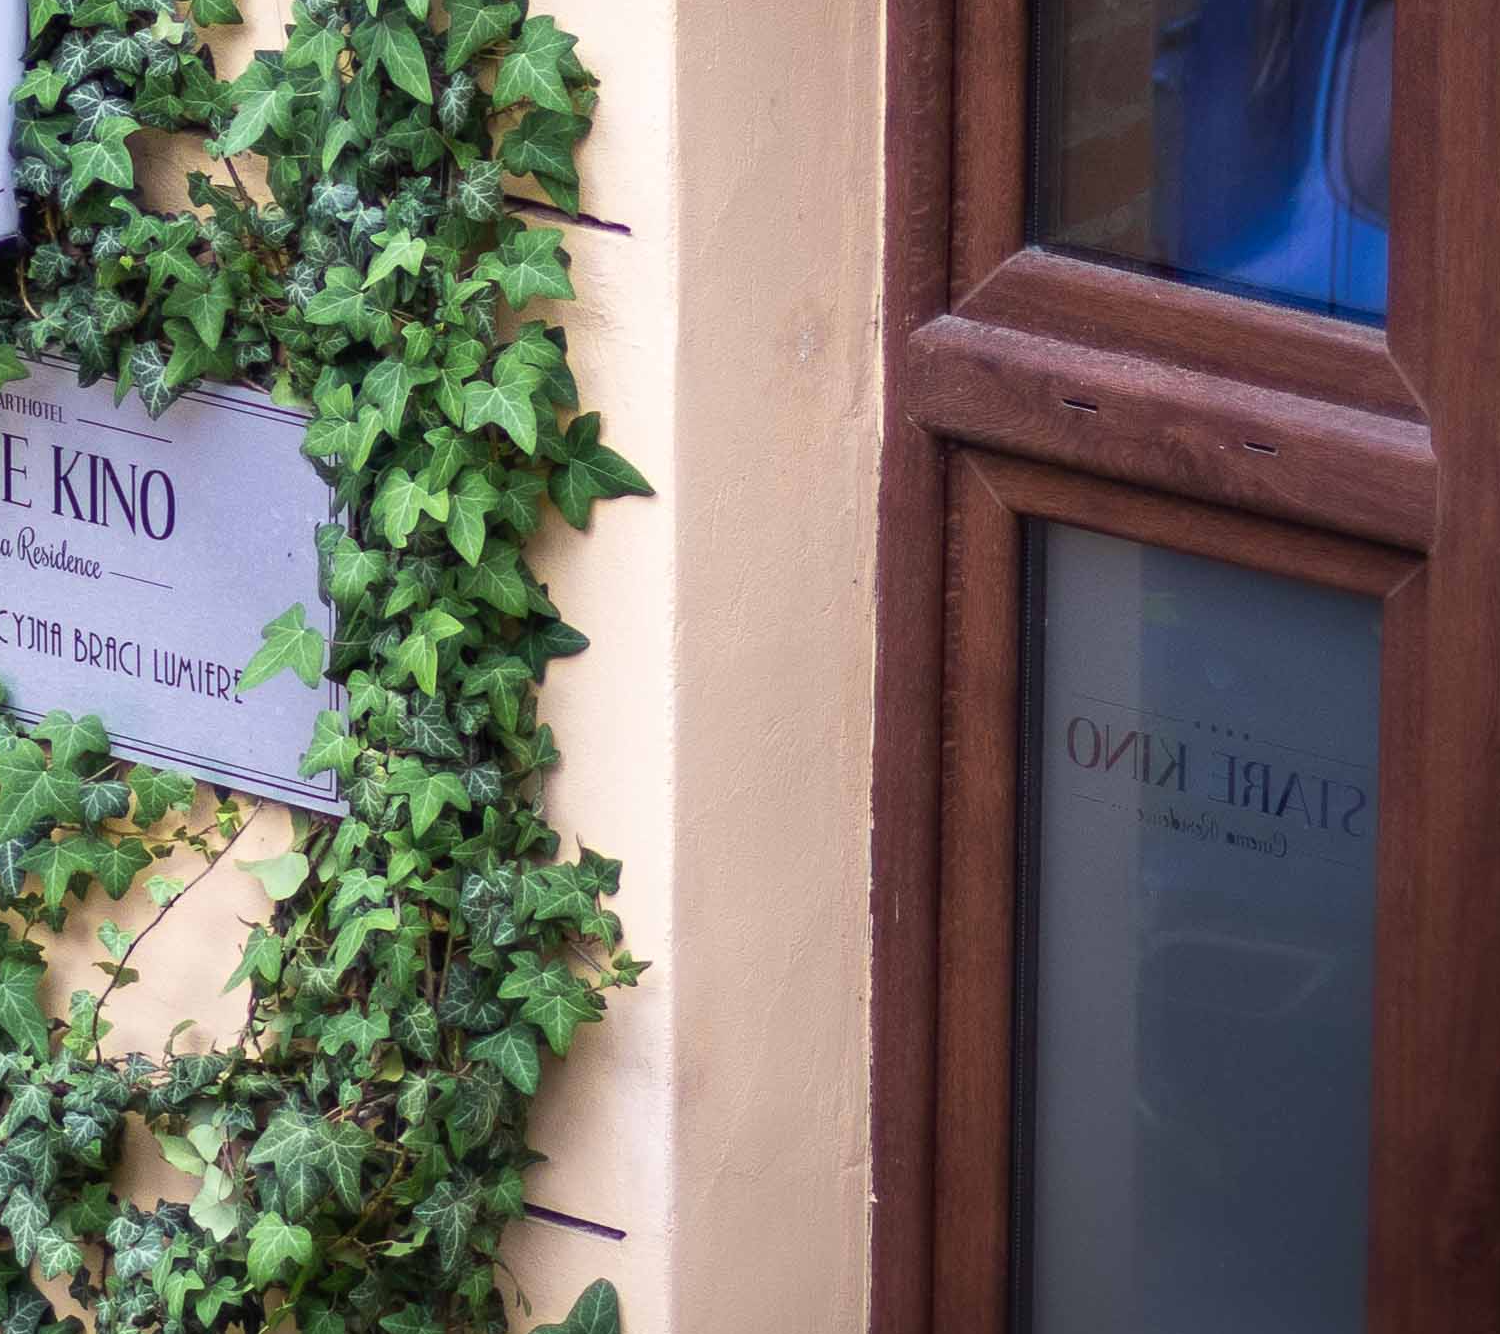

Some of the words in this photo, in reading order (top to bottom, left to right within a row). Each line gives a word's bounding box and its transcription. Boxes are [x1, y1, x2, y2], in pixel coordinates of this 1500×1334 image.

[51, 444, 176, 540] KINO
[17, 526, 103, 579] Residence
[73, 627, 141, 679] BRACI
[152, 648, 243, 705] LUMIERE
